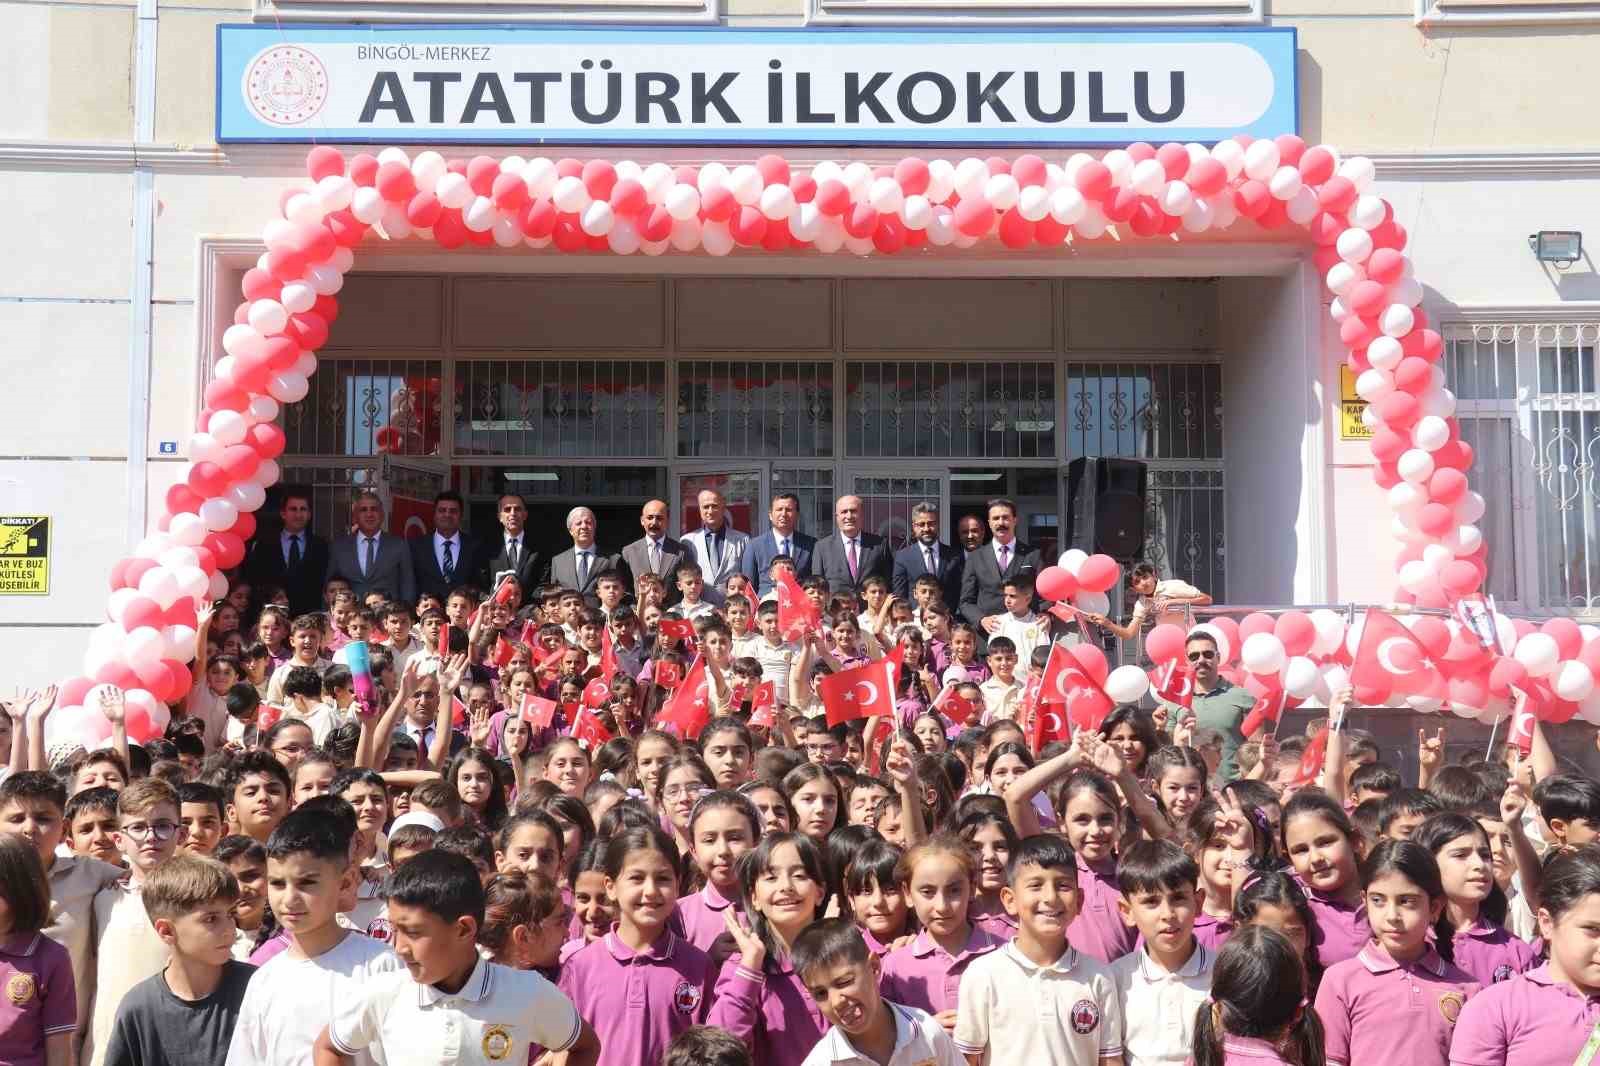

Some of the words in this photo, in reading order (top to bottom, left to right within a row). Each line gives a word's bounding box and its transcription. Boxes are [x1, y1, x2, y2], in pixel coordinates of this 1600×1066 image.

[357, 43, 491, 61] BİNGÖL-MERKEZ
[358, 59, 742, 124] ATATÜRK
[767, 59, 1186, 124] İLKOKULU
[164, 444, 172, 452] 6
[12, 560, 22, 568] VE
[26, 560, 43, 568] BUZ
[0, 581, 40, 590] ÜŞEBİLİR
